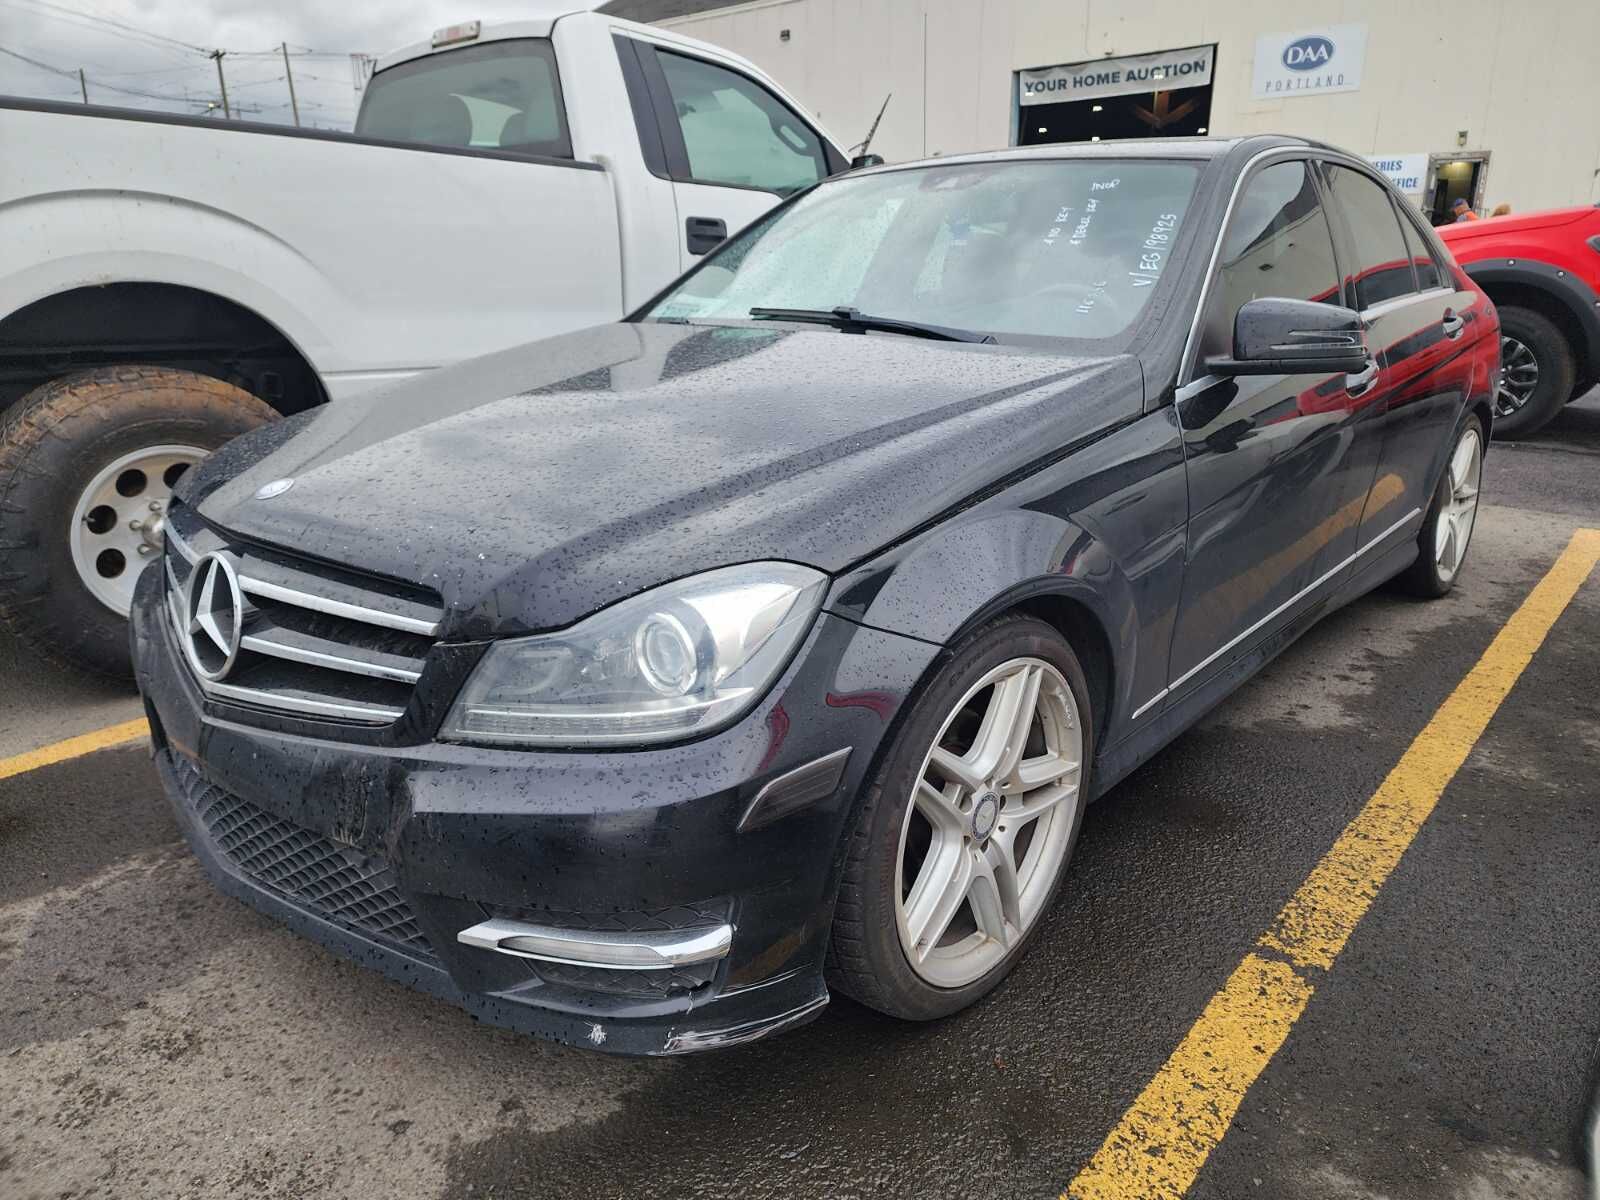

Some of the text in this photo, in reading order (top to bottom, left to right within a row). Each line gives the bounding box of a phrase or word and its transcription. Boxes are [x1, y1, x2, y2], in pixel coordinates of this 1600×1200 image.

[1287, 44, 1328, 64] DAA
[1025, 59, 1206, 94] YOUR HOME AUCTION
[1264, 73, 1344, 92] PORTLAND
